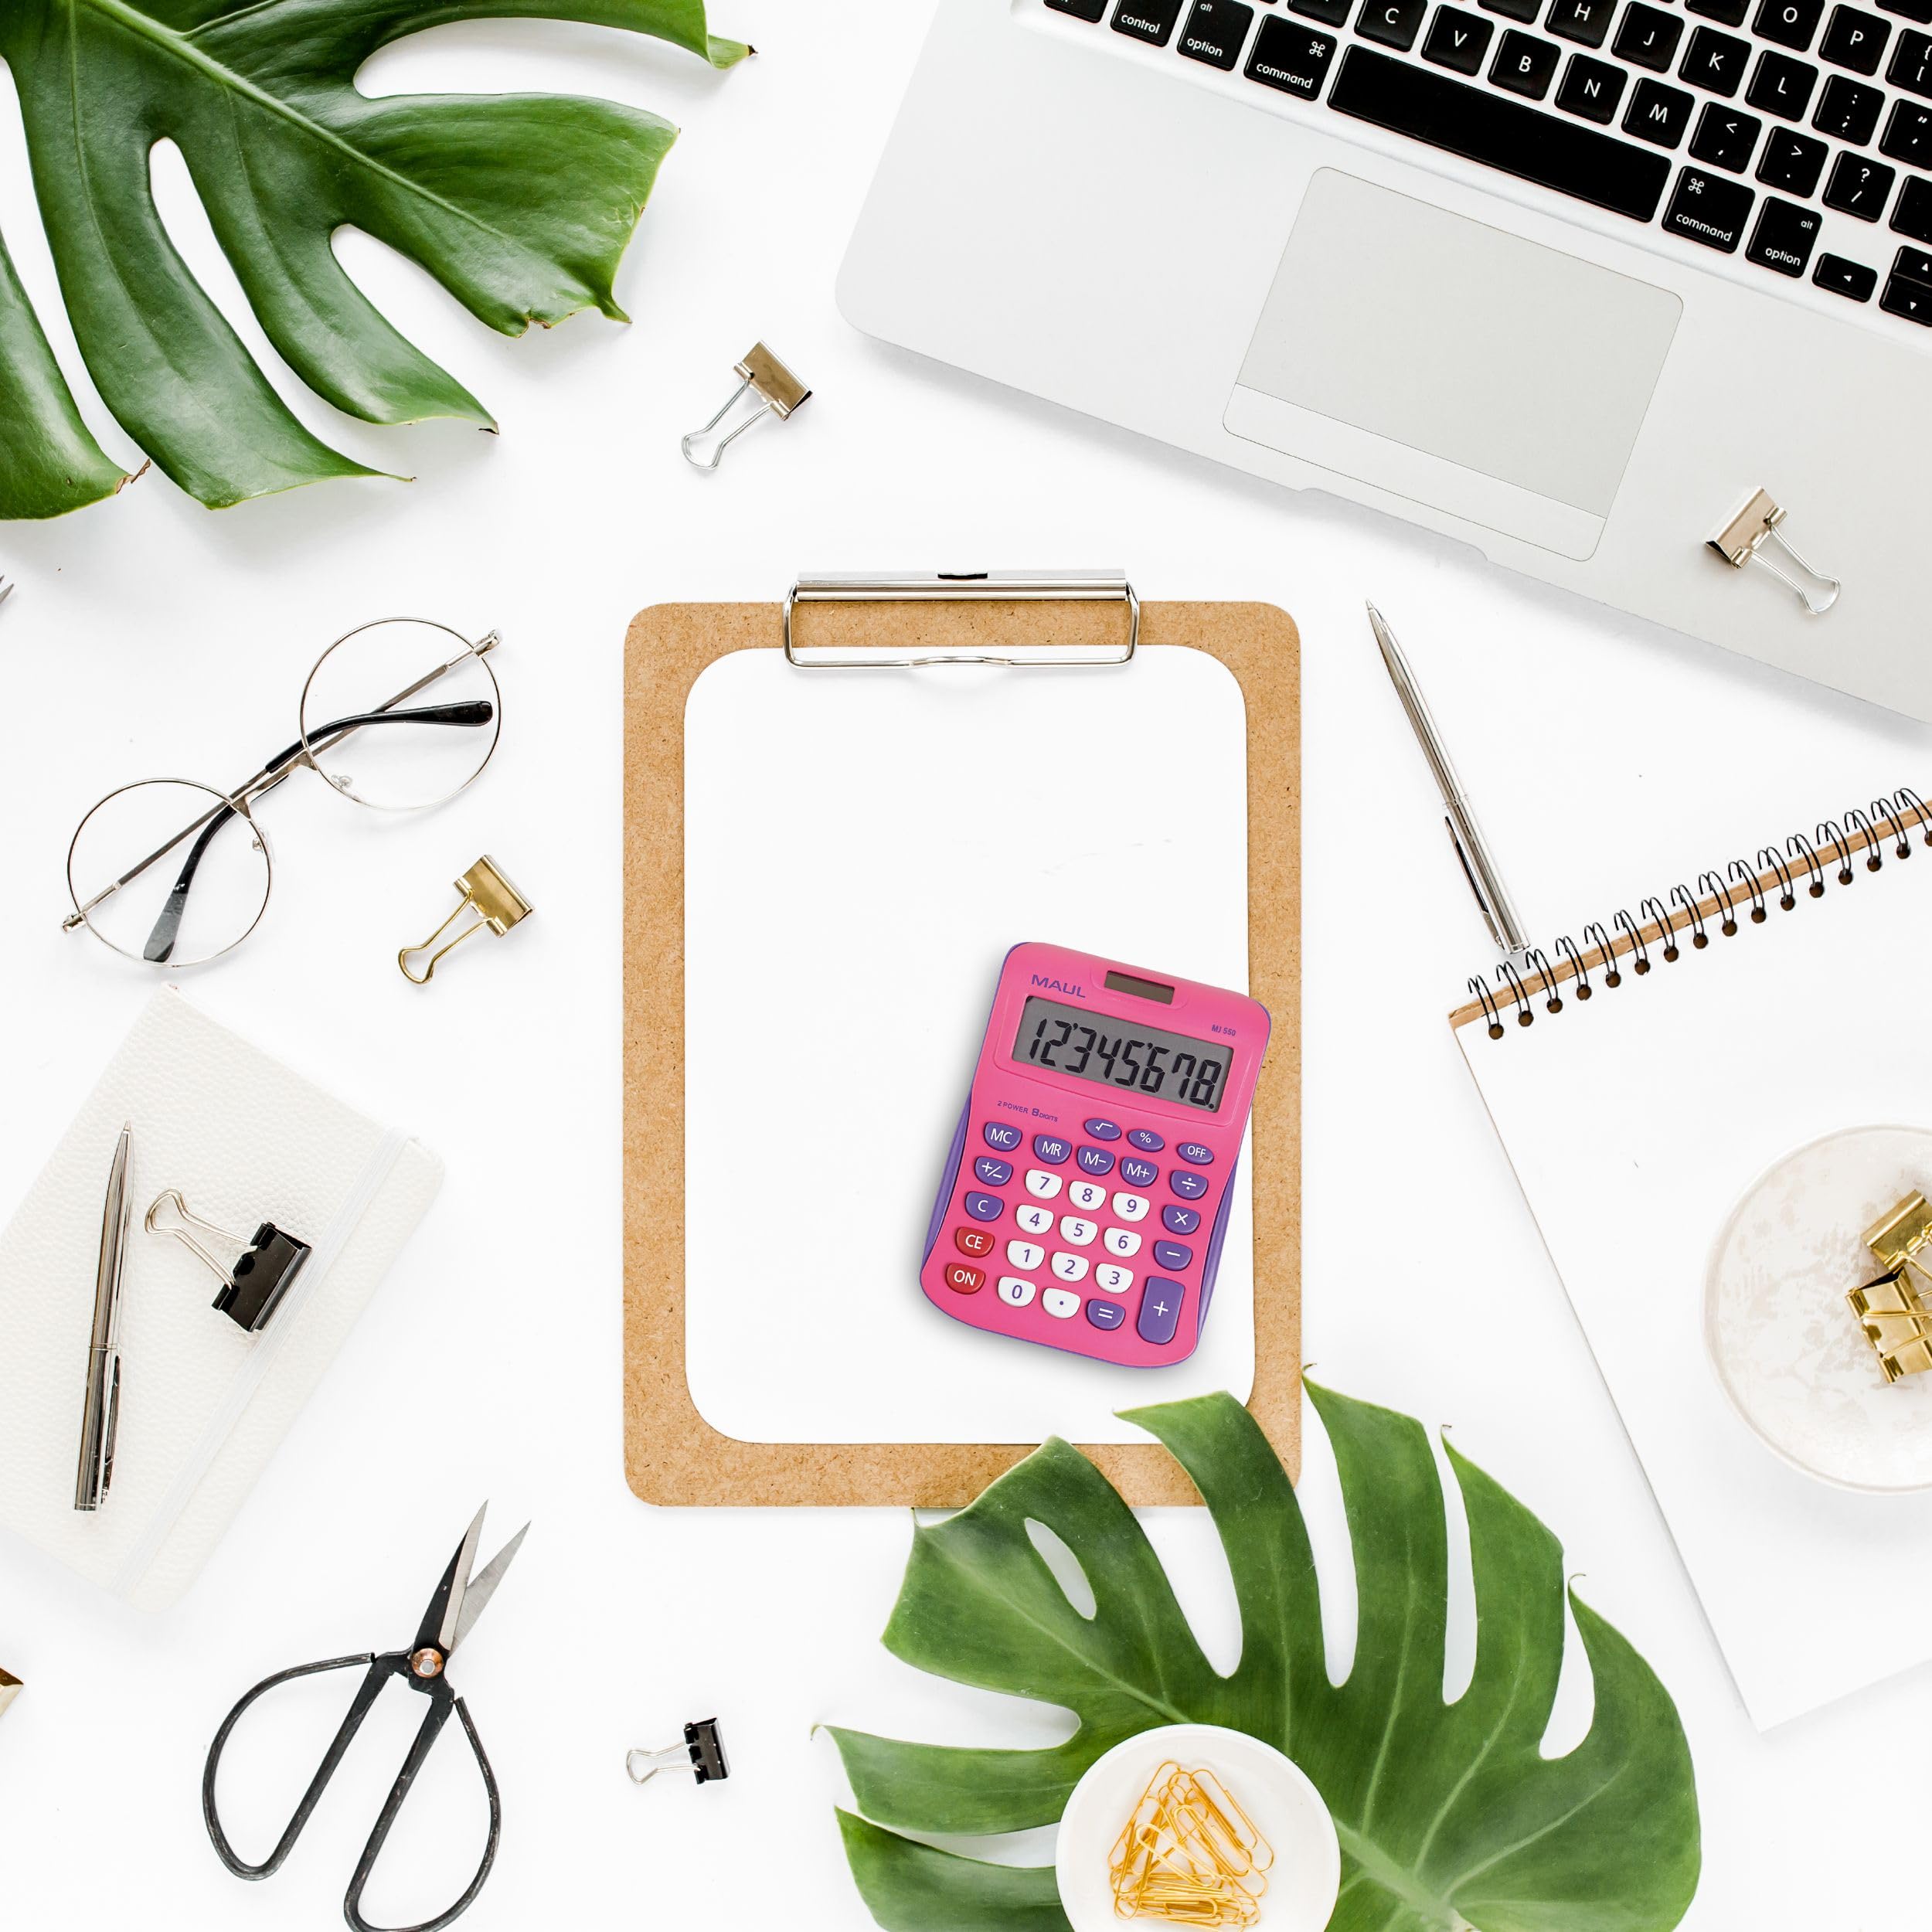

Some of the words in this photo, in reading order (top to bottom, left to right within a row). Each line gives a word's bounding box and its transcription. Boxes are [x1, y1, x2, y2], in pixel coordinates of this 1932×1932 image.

[1200, 2, 1213, 12] alt
[1574, 2, 1591, 22] H
[1783, 6, 1798, 23] O
[1121, 14, 1161, 34] control
[1385, 8, 1400, 24] C
[1454, 30, 1468, 47] V
[1643, 31, 1655, 46] J
[1849, 29, 1864, 46] P
[1186, 38, 1223, 58] option
[1519, 55, 1532, 73] B
[1709, 52, 1724, 71] K
[1256, 63, 1313, 89] command
[1583, 78, 1601, 98] N
[1777, 77, 1787, 94] L
[1648, 104, 1668, 124] M
[1675, 212, 1732, 243] command
[1801, 219, 1813, 230] alt
[1765, 246, 1801, 267] option
[1031, 974, 1086, 998] MAUL
[1211, 1024, 1222, 1033] MJ
[1223, 1027, 1236, 1036] 550
[1003, 1101, 1029, 1114] POWER
[990, 1128, 1012, 1145] MC
[1042, 1141, 1062, 1157] MR
[1187, 1145, 1206, 1158] OFF
[1127, 1162, 1150, 1179] M+
[1039, 1175, 1050, 1190] 7
[1081, 1188, 1094, 1202] 8
[978, 1199, 988, 1213] C
[1126, 1199, 1138, 1213] 9
[1029, 1213, 1040, 1226] 4
[1073, 1223, 1085, 1237] 5
[965, 1234, 983, 1250] CE
[1117, 1235, 1129, 1250] 6
[1024, 1248, 1031, 1263] 1
[1064, 1259, 1076, 1275] 2
[954, 1270, 976, 1286] ON
[1109, 1270, 1121, 1285] 3
[1012, 1284, 1023, 1299] 0
